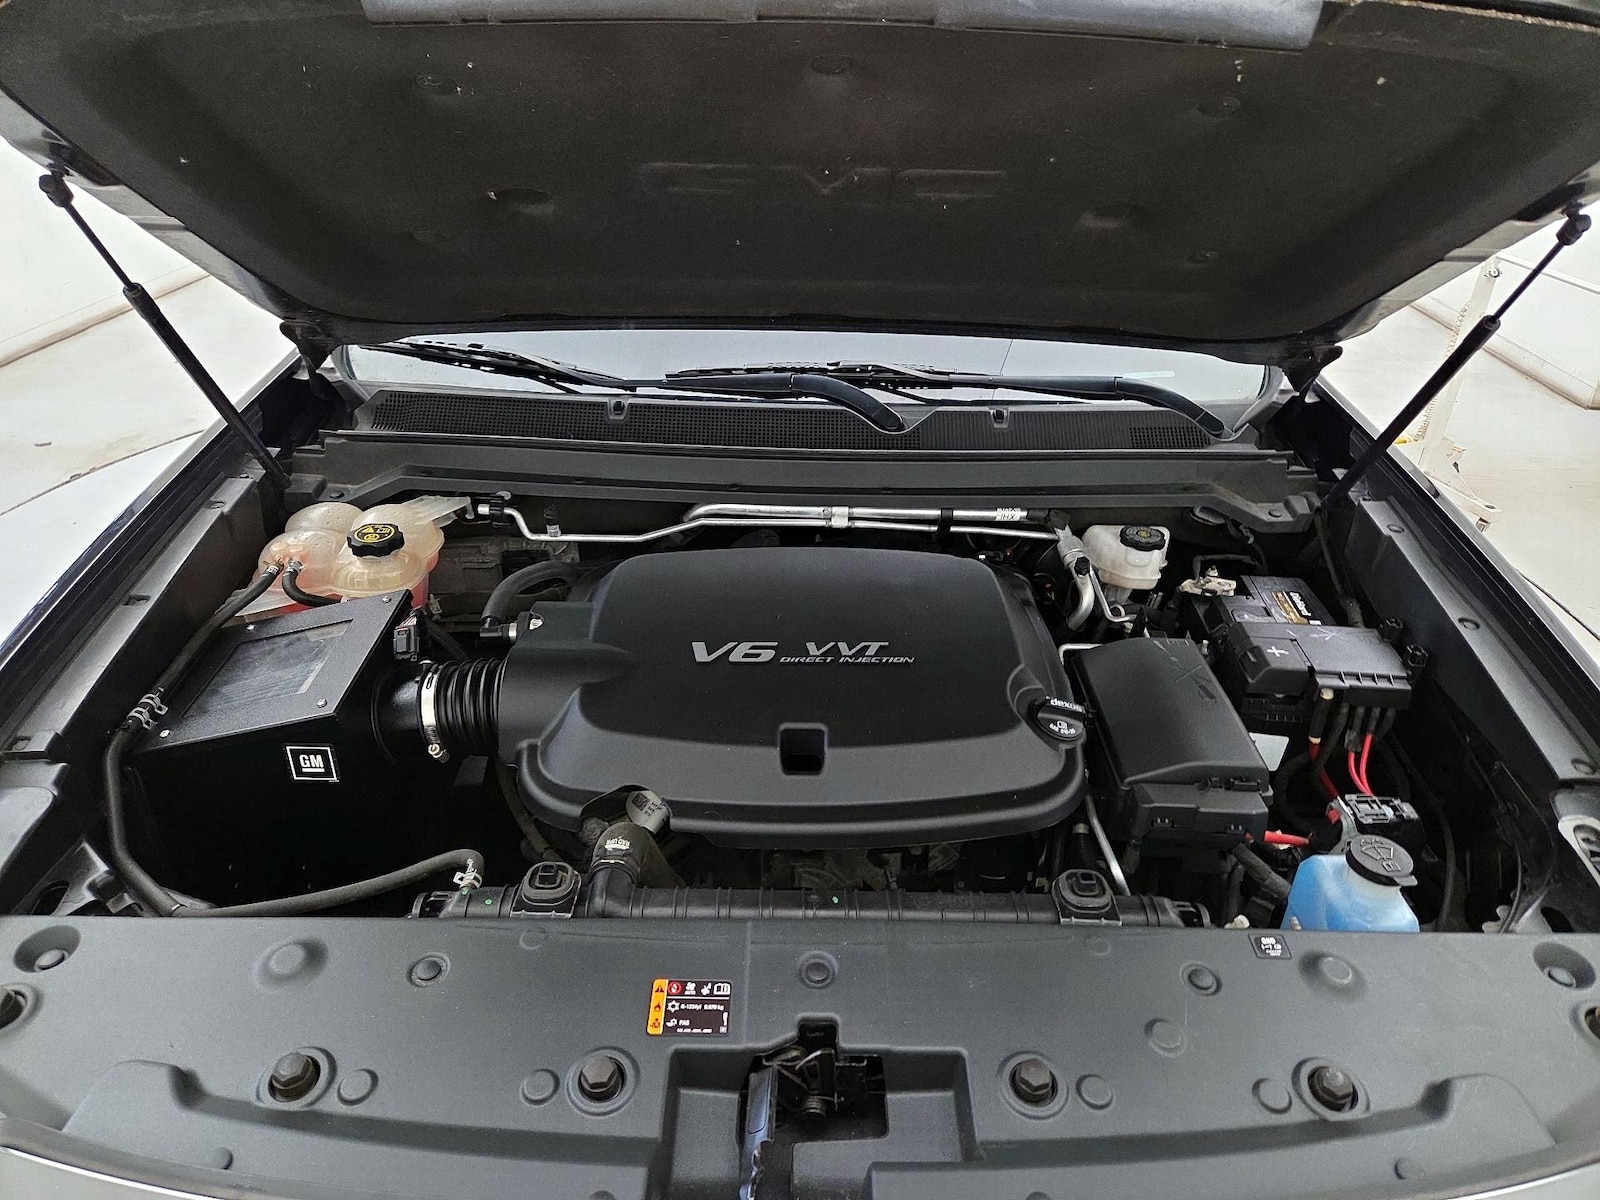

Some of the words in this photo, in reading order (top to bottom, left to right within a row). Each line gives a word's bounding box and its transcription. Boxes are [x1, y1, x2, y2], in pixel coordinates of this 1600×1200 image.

[691, 641, 779, 663] V6
[805, 641, 890, 656] VVT
[839, 656, 915, 664] INJECTION
[299, 754, 325, 768] GM
